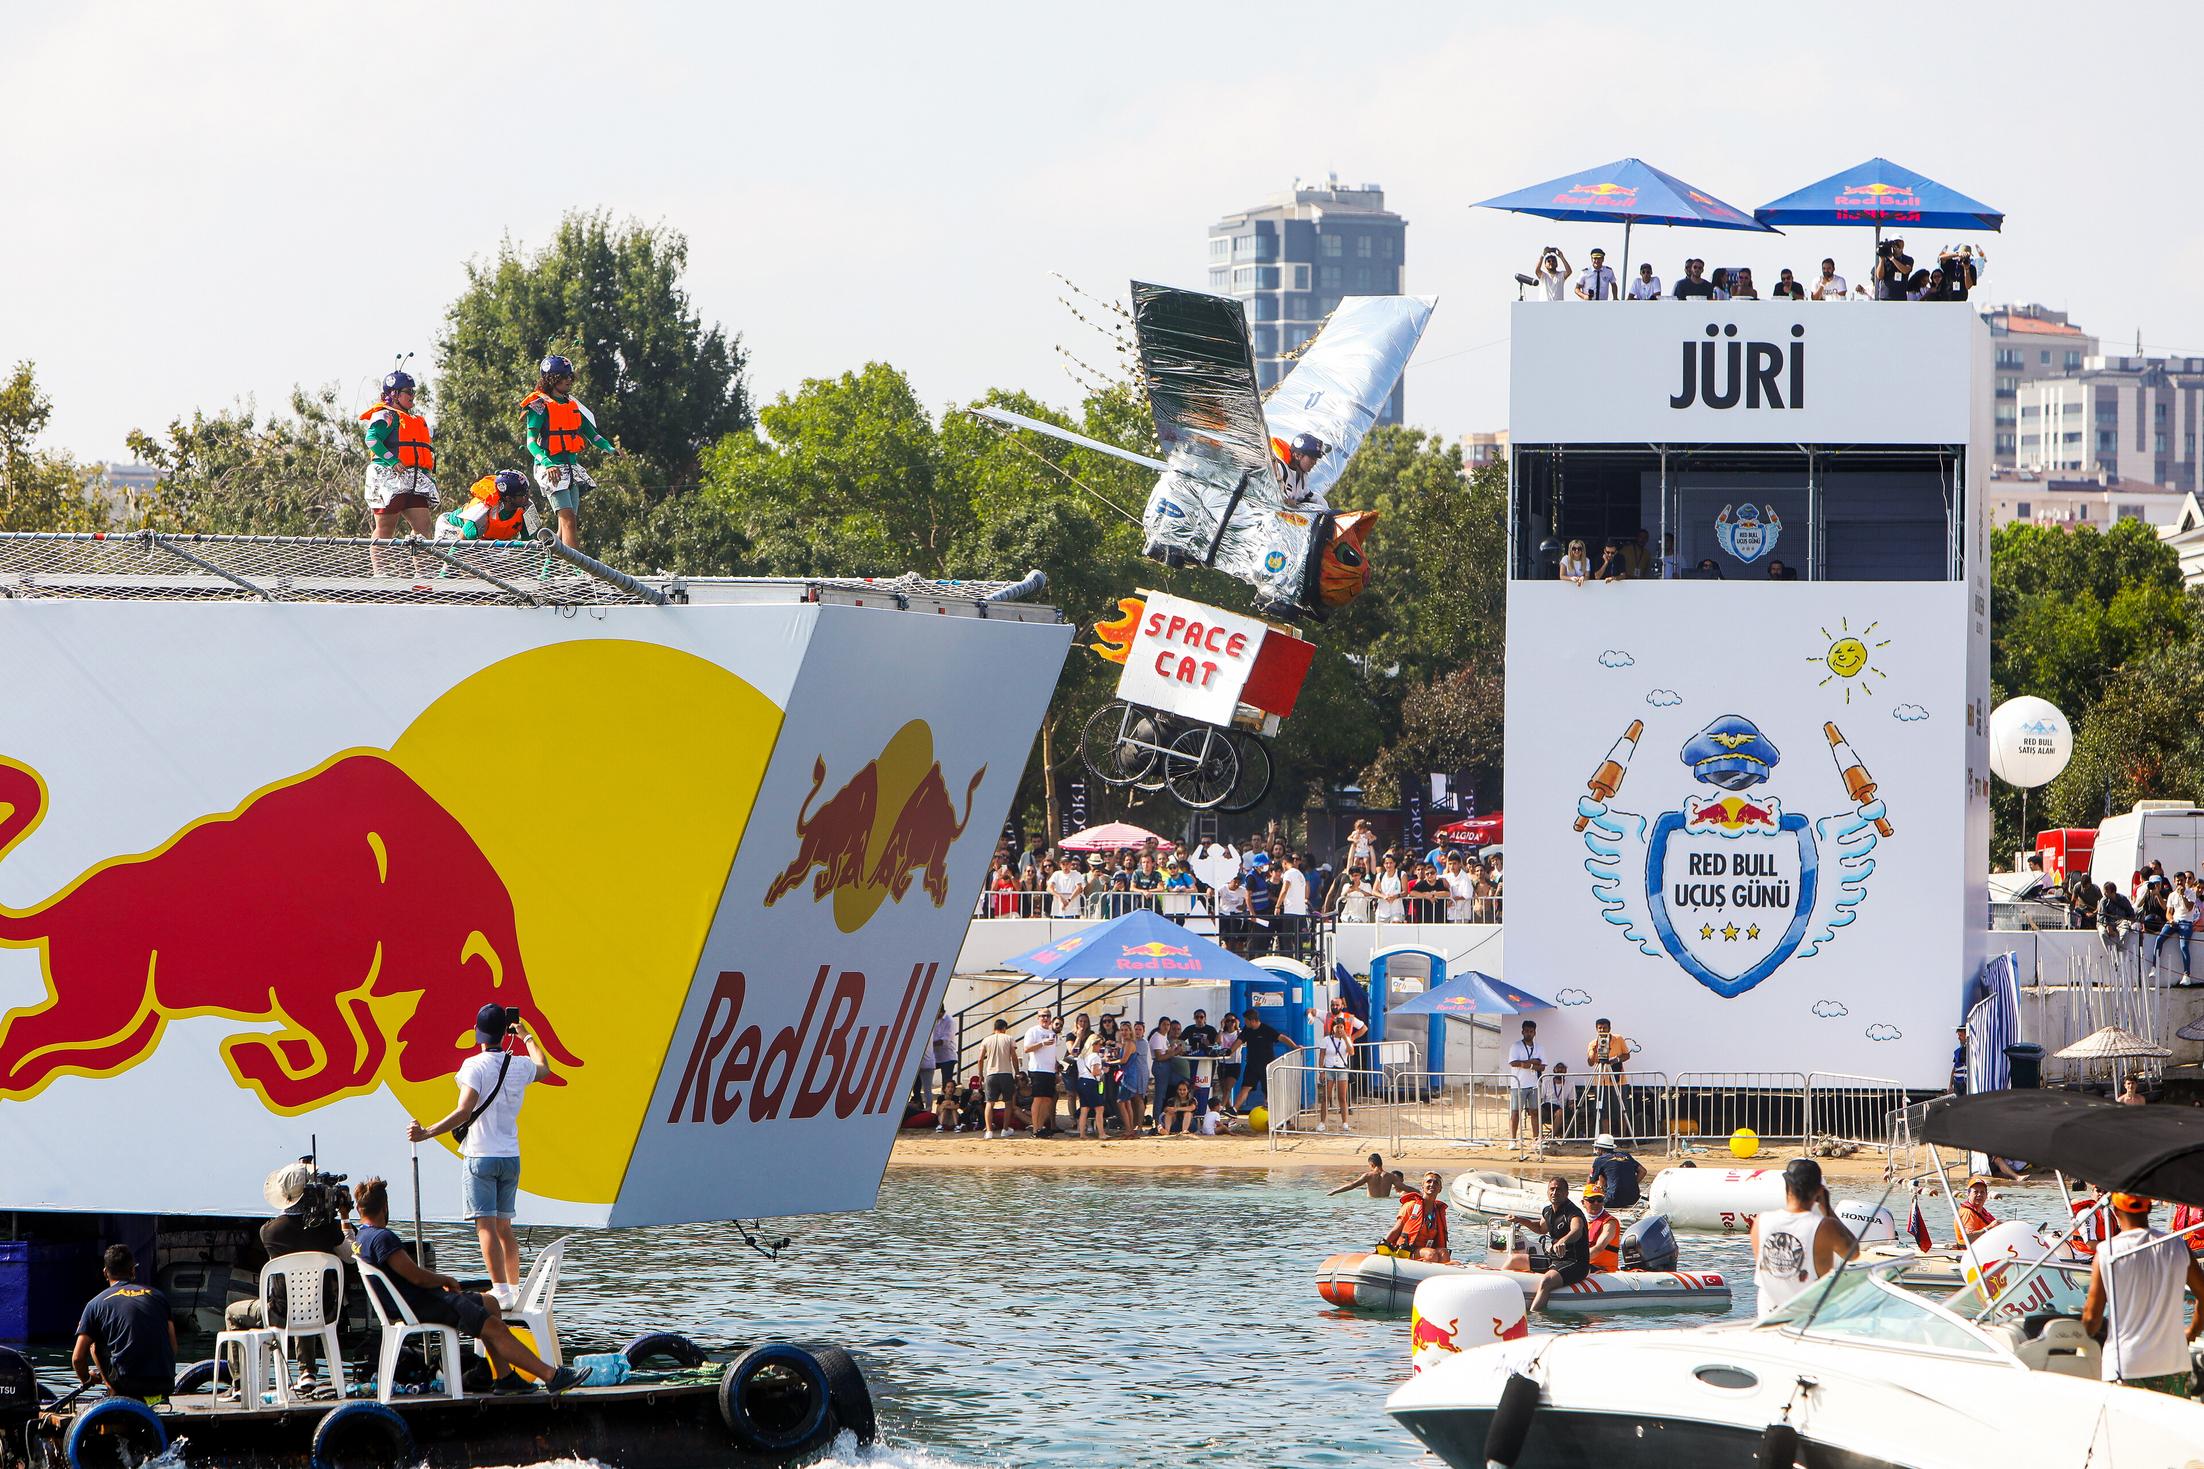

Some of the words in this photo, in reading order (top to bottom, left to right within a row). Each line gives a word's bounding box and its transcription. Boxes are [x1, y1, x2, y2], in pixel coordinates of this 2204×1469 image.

[1552, 193, 1596, 205] Red
[1597, 195, 1637, 208] Bull
[1835, 196, 1877, 205] Red
[1879, 196, 1921, 206] Bull
[1670, 324, 1805, 409] JÜRİ
[1144, 613, 1248, 658] SPACE
[1155, 650, 1218, 686] CAT
[2023, 738, 2037, 746] RED
[2038, 738, 2053, 746] BULL
[2018, 746, 2036, 755] SATIŞ
[2037, 747, 2056, 755] ALANI
[1449, 831, 1480, 841] ALGIDA
[1689, 853, 1727, 876] RED
[1733, 853, 1778, 877] BULL
[1675, 884, 1726, 913] UÇUŞ
[1732, 879, 1790, 908] GÜNÜ
[1116, 958, 1159, 970] Red
[1161, 958, 1202, 971] Bull
[667, 964, 831, 1125] Red
[789, 962, 939, 1119] Bull
[1720, 1211, 1735, 1231] Re
[1840, 1212, 1883, 1225] HONDA
[0, 1386, 16, 1395] TSU
